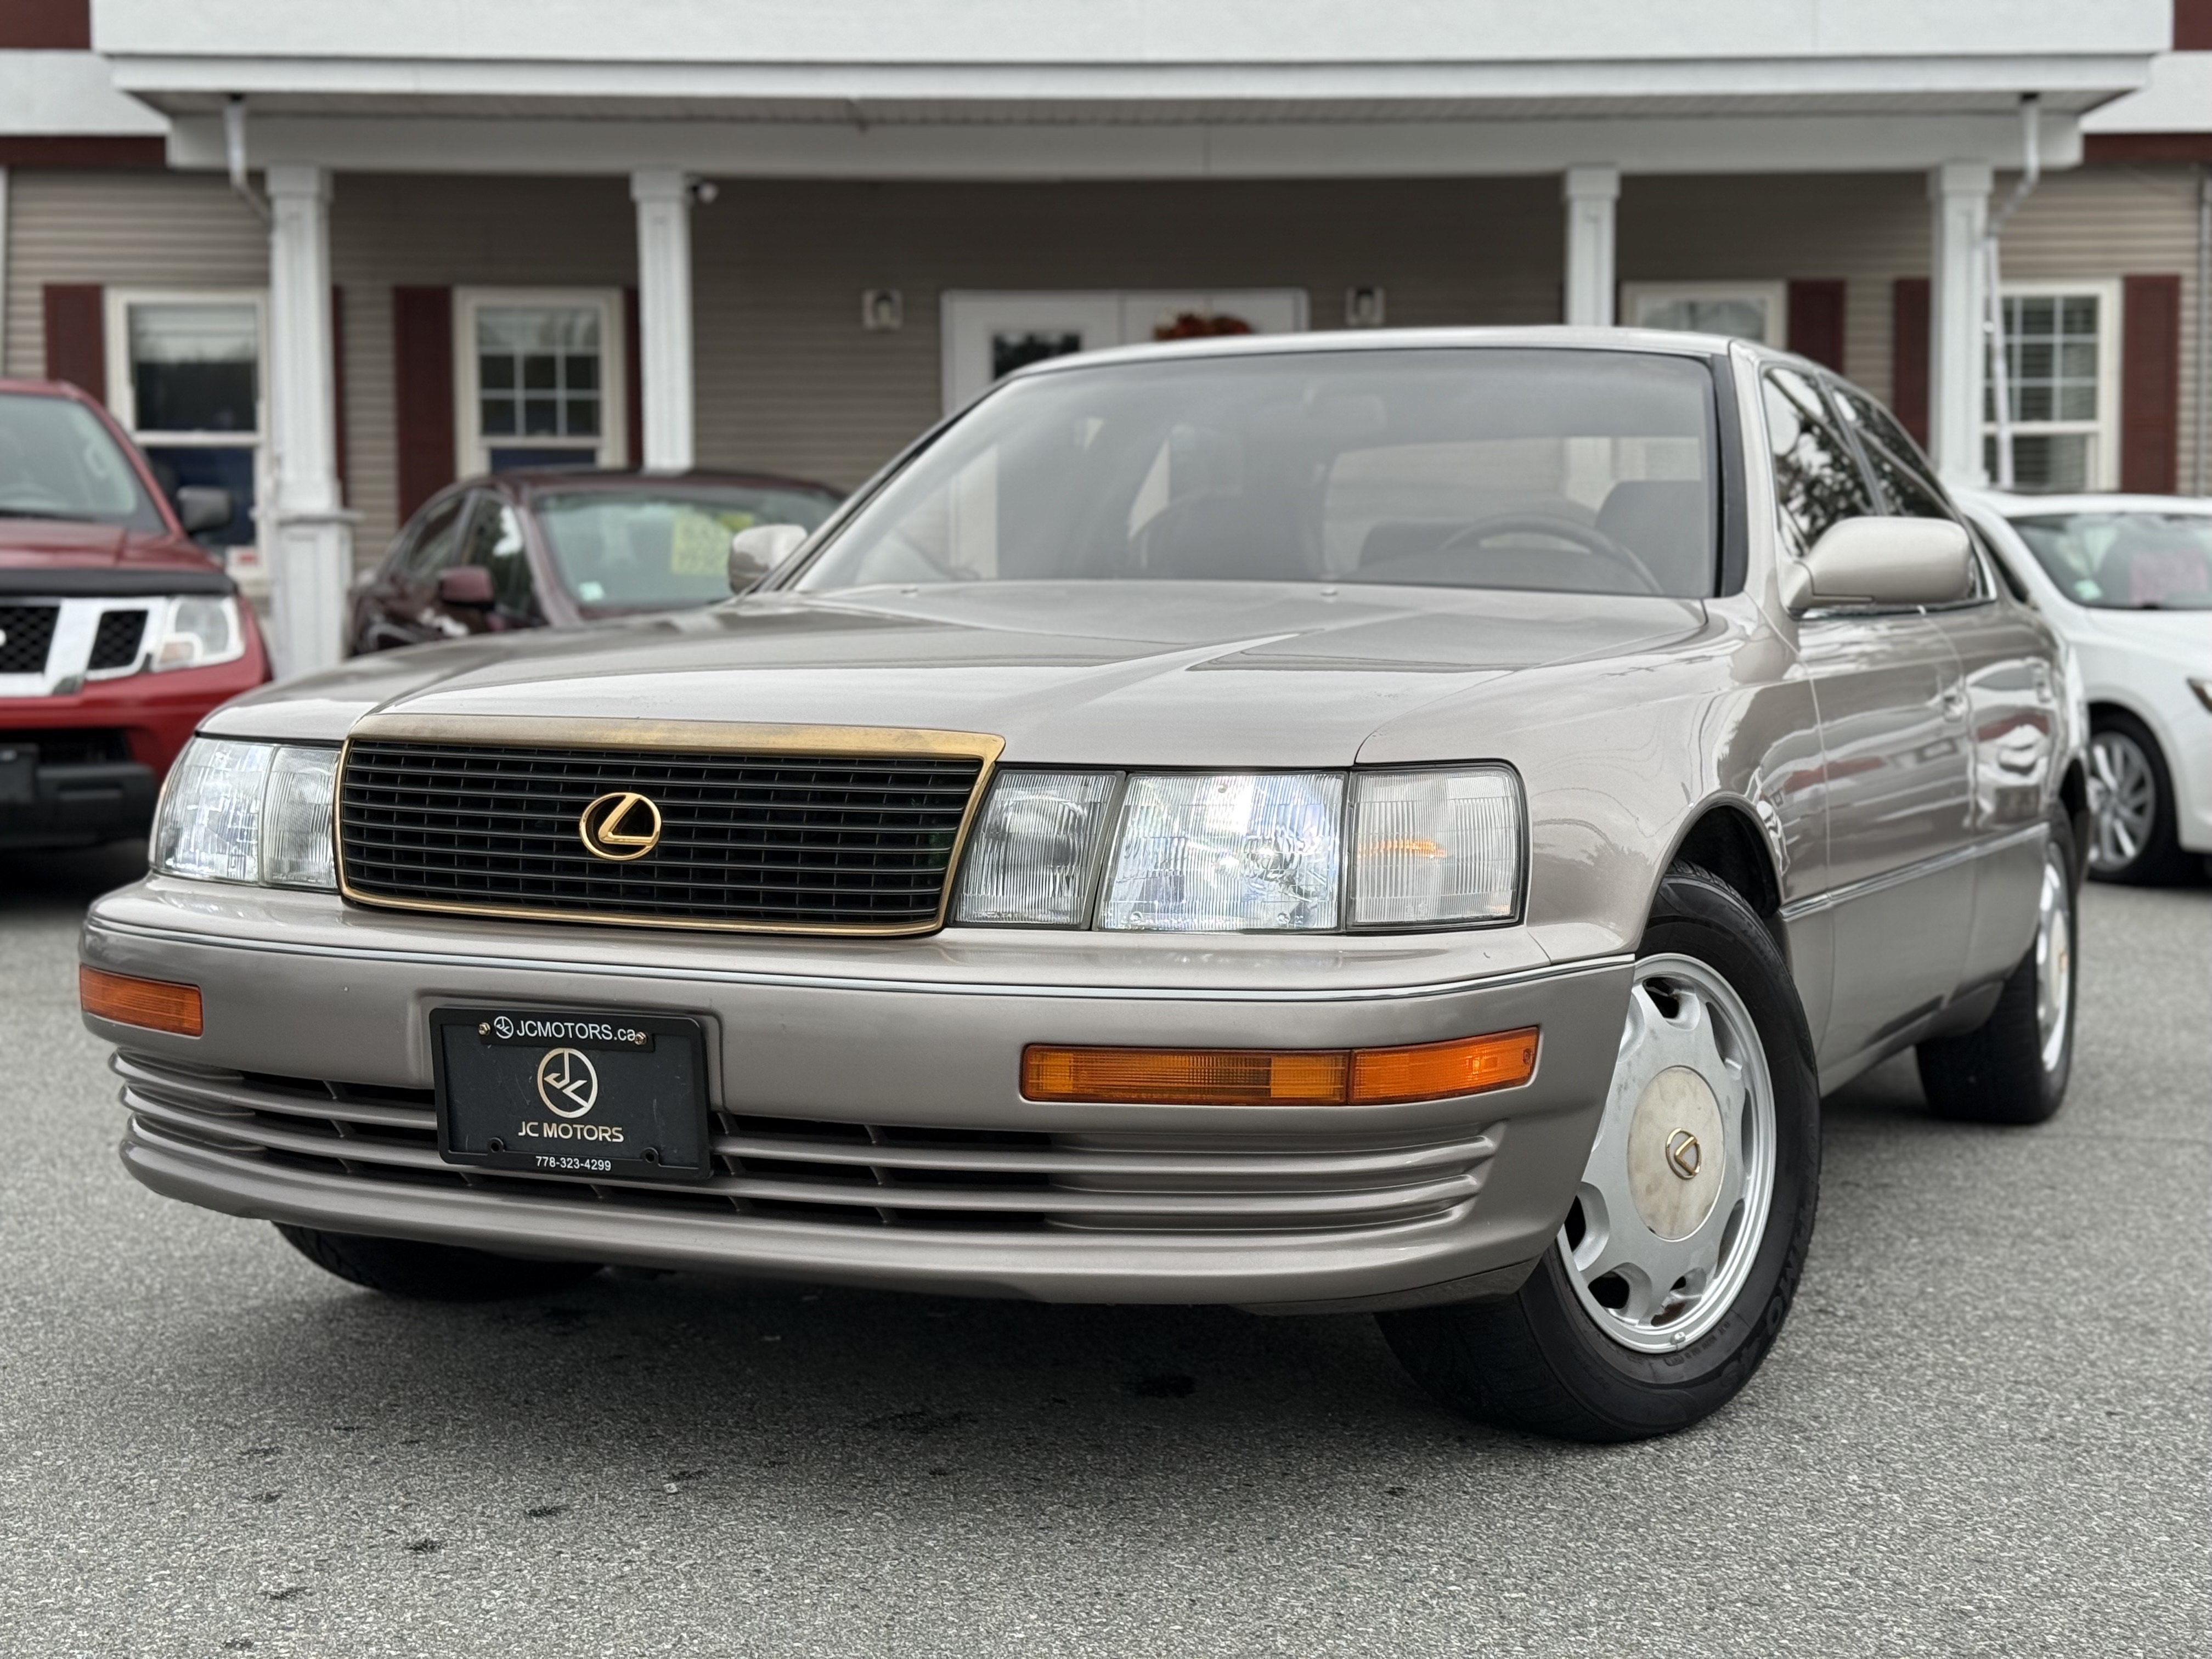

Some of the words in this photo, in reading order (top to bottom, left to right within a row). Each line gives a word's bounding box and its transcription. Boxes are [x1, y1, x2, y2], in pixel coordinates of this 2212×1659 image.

[517, 1020, 636, 1041] JCMOTORS.ca
[518, 1121, 539, 1137] JC
[543, 1122, 624, 1142] MOTORS
[536, 1156, 611, 1171] 778-323-4299
